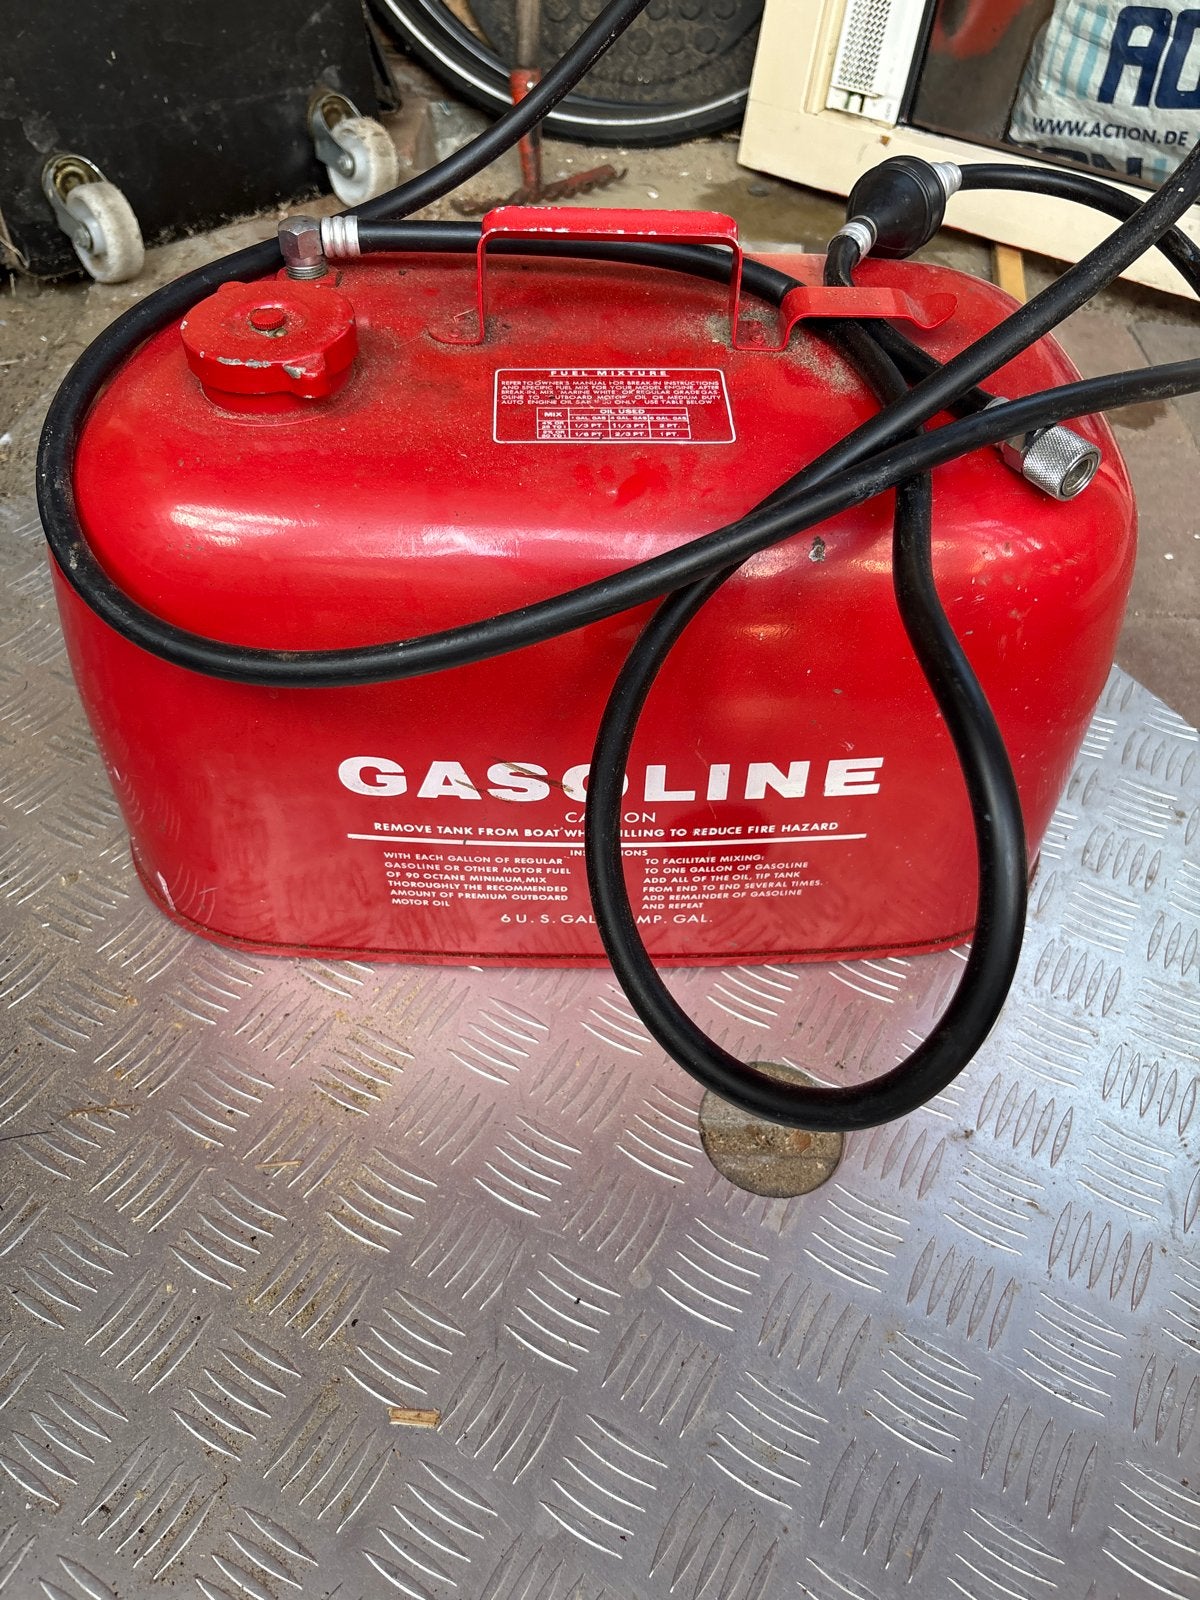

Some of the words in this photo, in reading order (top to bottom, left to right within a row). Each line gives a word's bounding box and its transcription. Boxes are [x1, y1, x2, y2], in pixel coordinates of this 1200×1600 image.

[1032, 117, 1189, 146] WWW.ACTION.DE
[374, 822, 432, 833] REMOVE
[437, 826, 473, 835] TANK
[478, 827, 519, 836] FROM
[524, 829, 559, 837] BOAT
[620, 829, 664, 837] ILLING
[693, 826, 742, 836] REDUCE
[748, 825, 775, 834] FIRE
[781, 822, 838, 832] HAZARD
[448, 855, 491, 863] GALLON
[385, 862, 440, 870] GASOLINE
[690, 865, 732, 873] GALLON
[755, 862, 808, 870] GASOLINE
[423, 873, 465, 881] OCTANE
[388, 880, 460, 889] THOROUGHLY
[390, 889, 436, 897] AMOUNT
[458, 892, 507, 900] PREMIUM
[750, 889, 802, 898] GASOLINE
[392, 898, 429, 906] MOTOR
[501, 914, 511, 923] 6
[637, 915, 667, 924] MP.
[673, 914, 713, 923] GAL.
